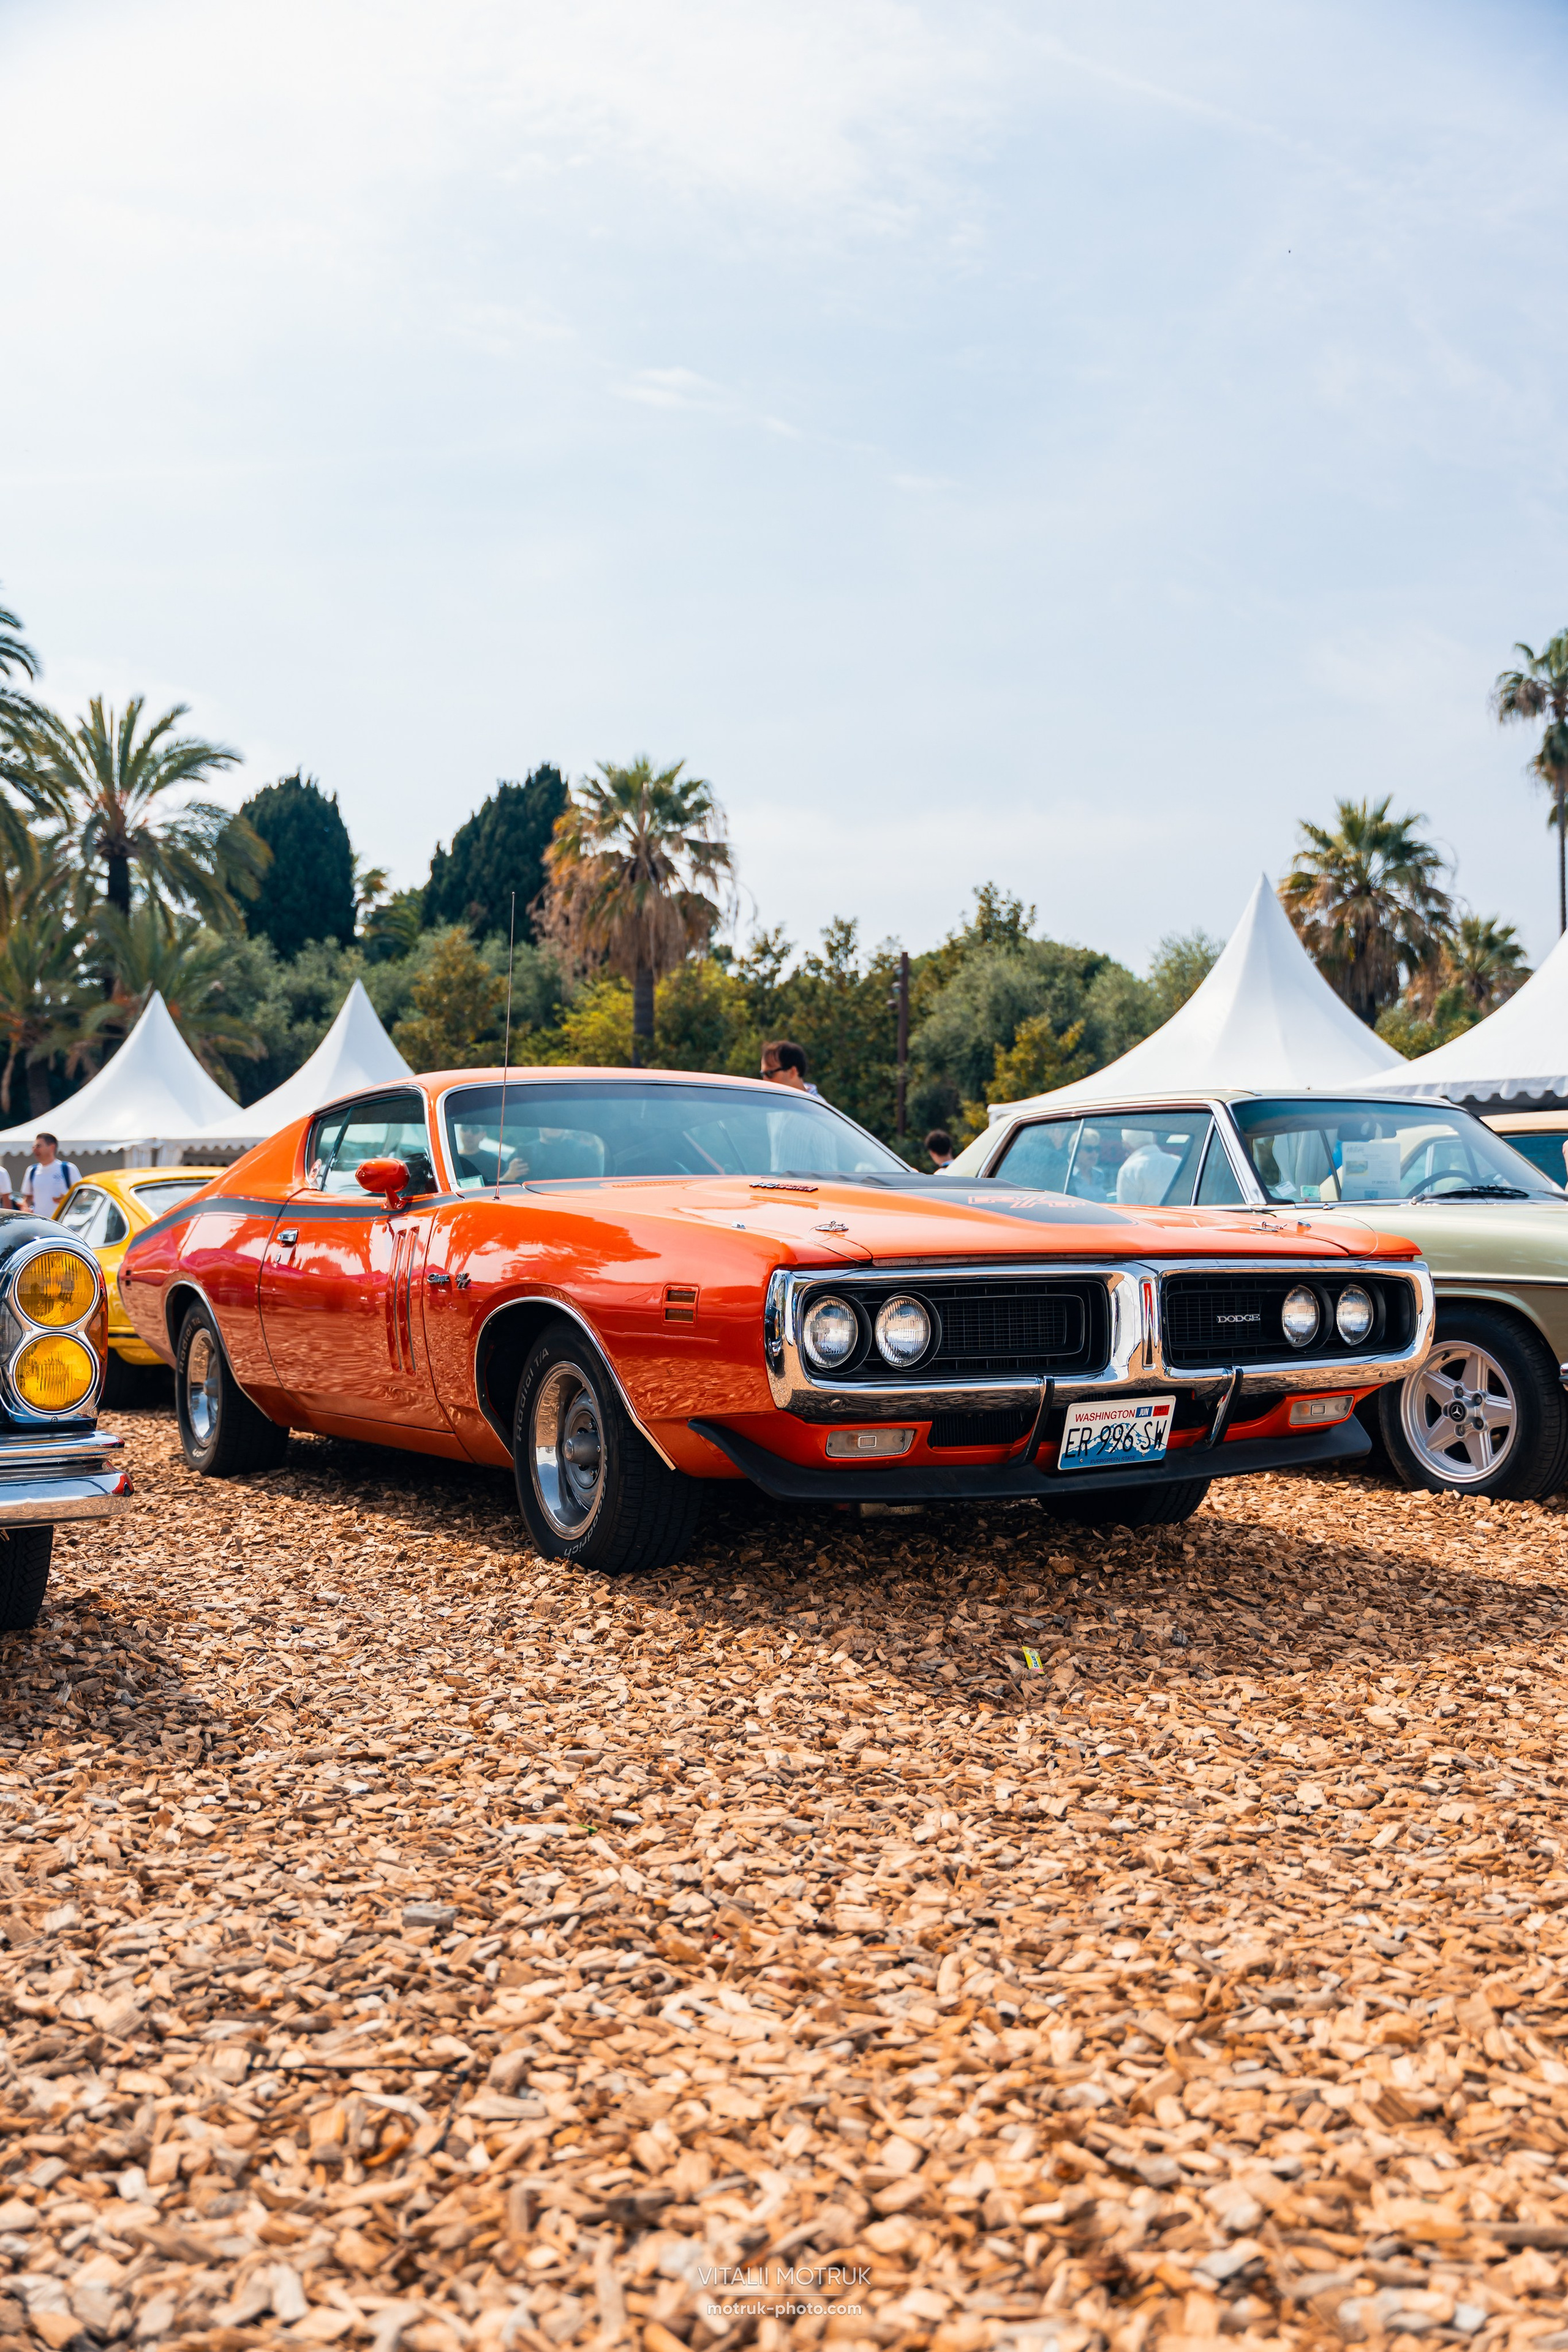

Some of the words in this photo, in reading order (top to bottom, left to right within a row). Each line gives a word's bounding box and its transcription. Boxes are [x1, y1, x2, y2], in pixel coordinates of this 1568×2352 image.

[1217, 1314, 1261, 1323] DODGE
[516, 1368, 533, 1442] Radial
[533, 1348, 549, 1367] T/A
[1075, 1409, 1136, 1422] WASHINGTON
[1139, 1408, 1149, 1416] JUN
[1064, 1427, 1092, 1458] ER
[1096, 1422, 1137, 1455] 996
[1140, 1420, 1167, 1450] SW
